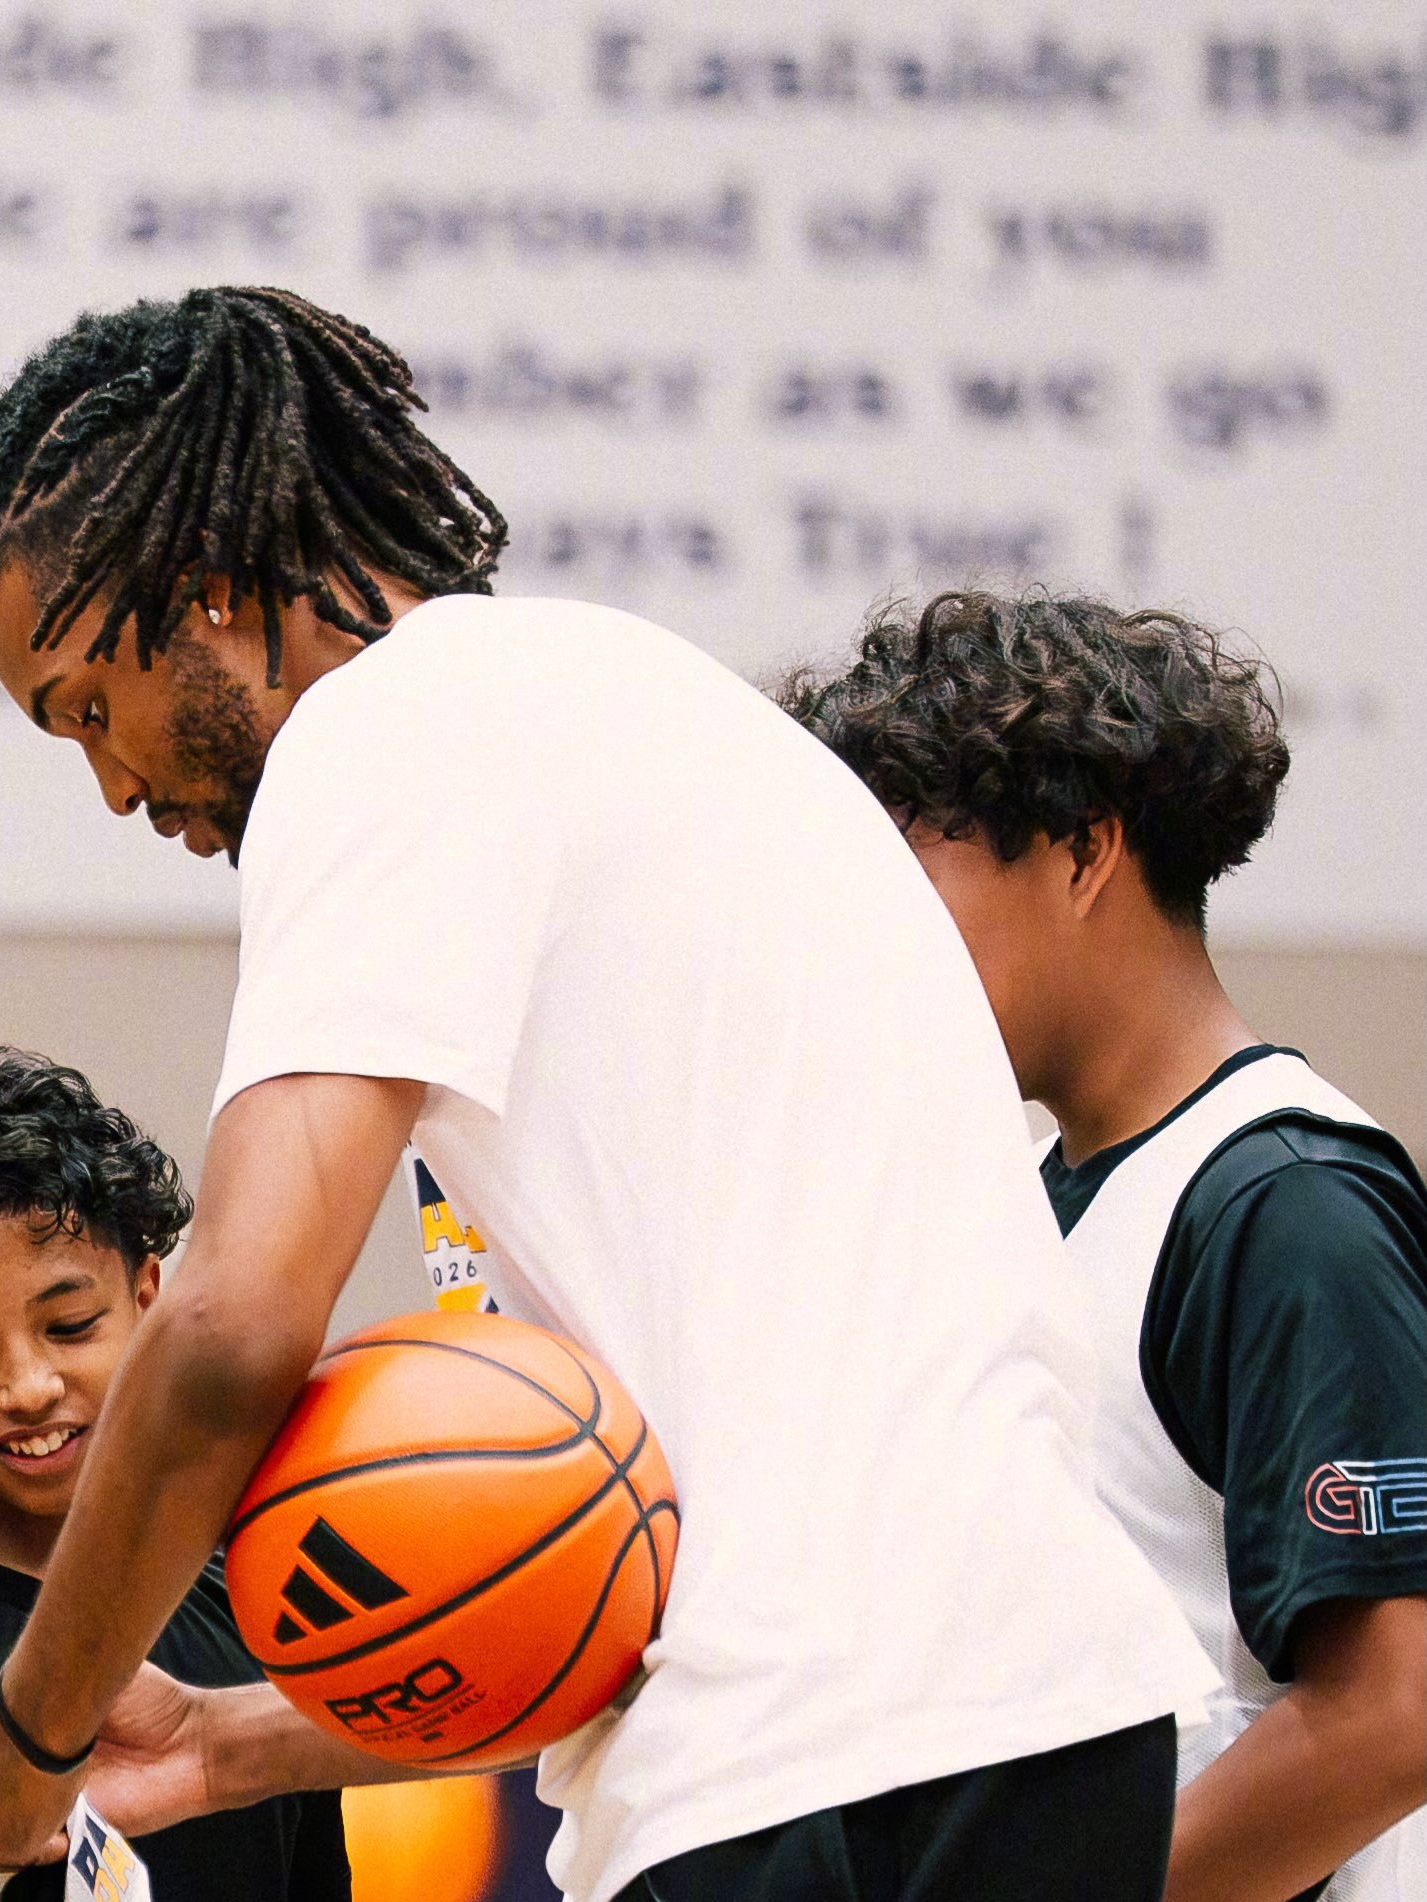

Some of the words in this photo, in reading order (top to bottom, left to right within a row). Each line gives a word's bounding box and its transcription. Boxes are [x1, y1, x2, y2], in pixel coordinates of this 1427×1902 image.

[584, 16, 1154, 128] Eastside
[1192, 22, 1427, 149] Hig
[106, 188, 308, 258] are
[360, 170, 762, 278] proud
[797, 172, 944, 270] of
[978, 198, 1222, 302] you
[759, 355, 904, 428] as
[944, 355, 1116, 430] we
[1160, 355, 1338, 455] go
[432, 1260, 478, 1287] 026
[324, 1658, 462, 1733] PRO
